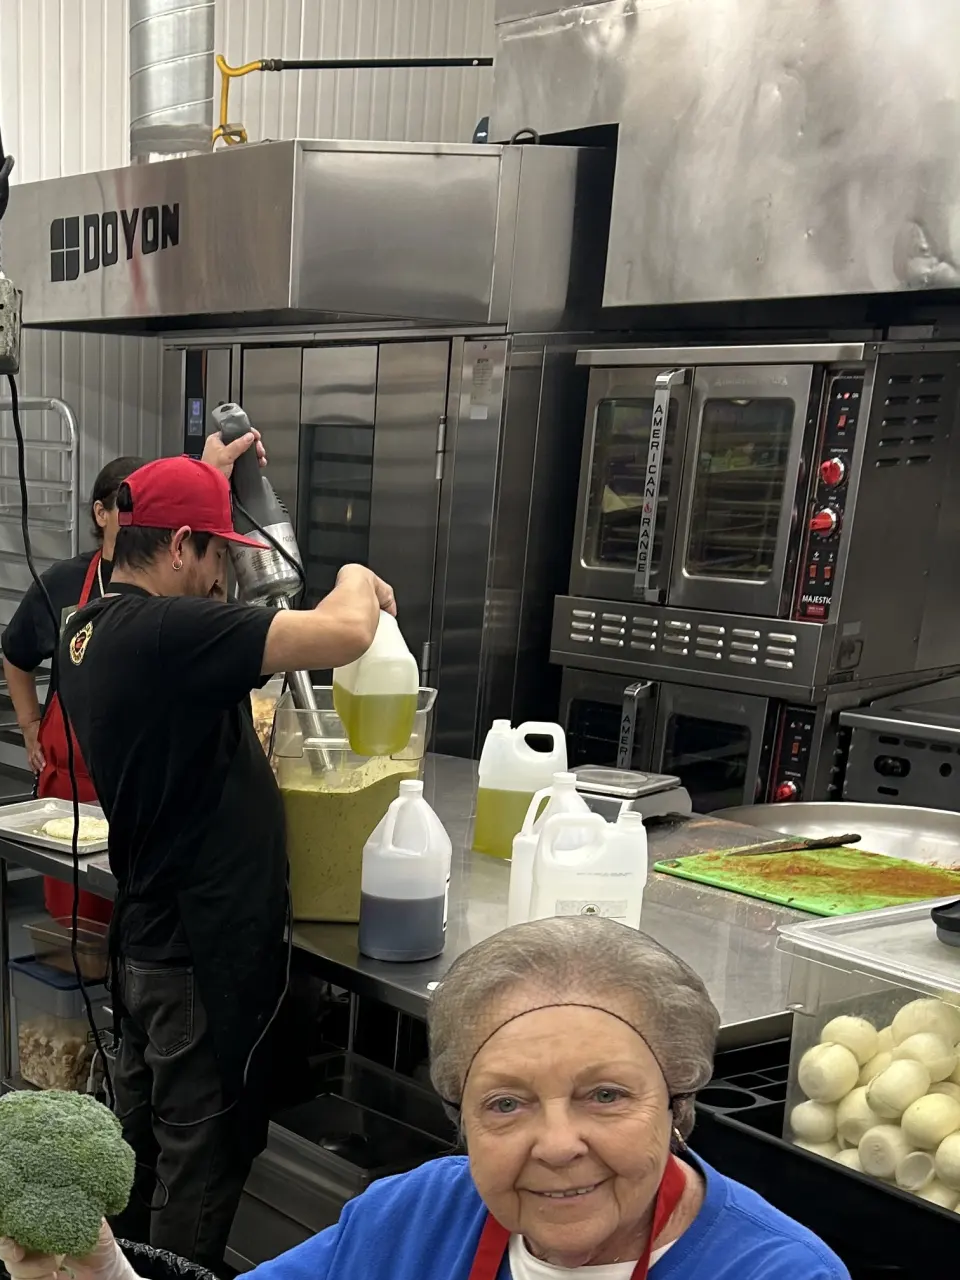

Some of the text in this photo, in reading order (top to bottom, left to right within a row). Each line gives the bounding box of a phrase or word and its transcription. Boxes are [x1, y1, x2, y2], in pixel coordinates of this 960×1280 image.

[83, 203, 180, 273] DOYON
[638, 404, 663, 573] AMERICAN RANGE
[801, 594, 832, 604] MAJESTIC
